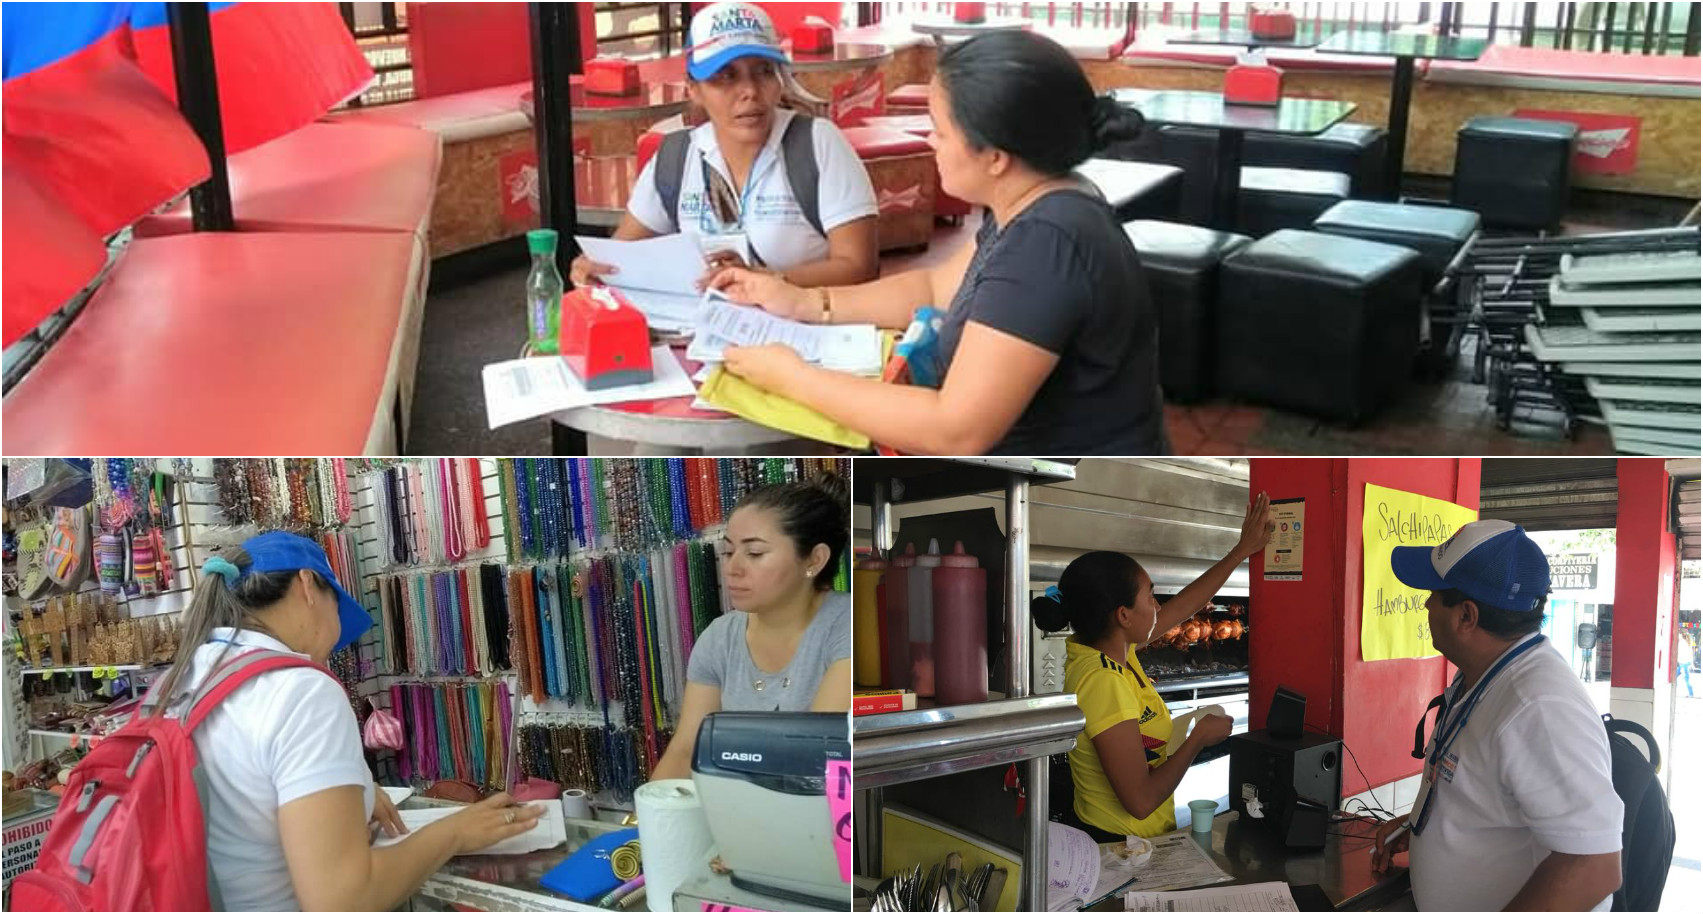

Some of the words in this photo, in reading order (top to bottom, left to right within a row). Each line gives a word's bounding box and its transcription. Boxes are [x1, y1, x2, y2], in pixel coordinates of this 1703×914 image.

[1549, 574, 1592, 588] AVERA
[1373, 588, 1429, 616] HAMBURG
[1139, 712, 1158, 725] adidas
[722, 752, 762, 762] CASIO
[8, 841, 32, 856] PASO
[35, 838, 41, 847] A
[2, 849, 41, 869] ERSONA
